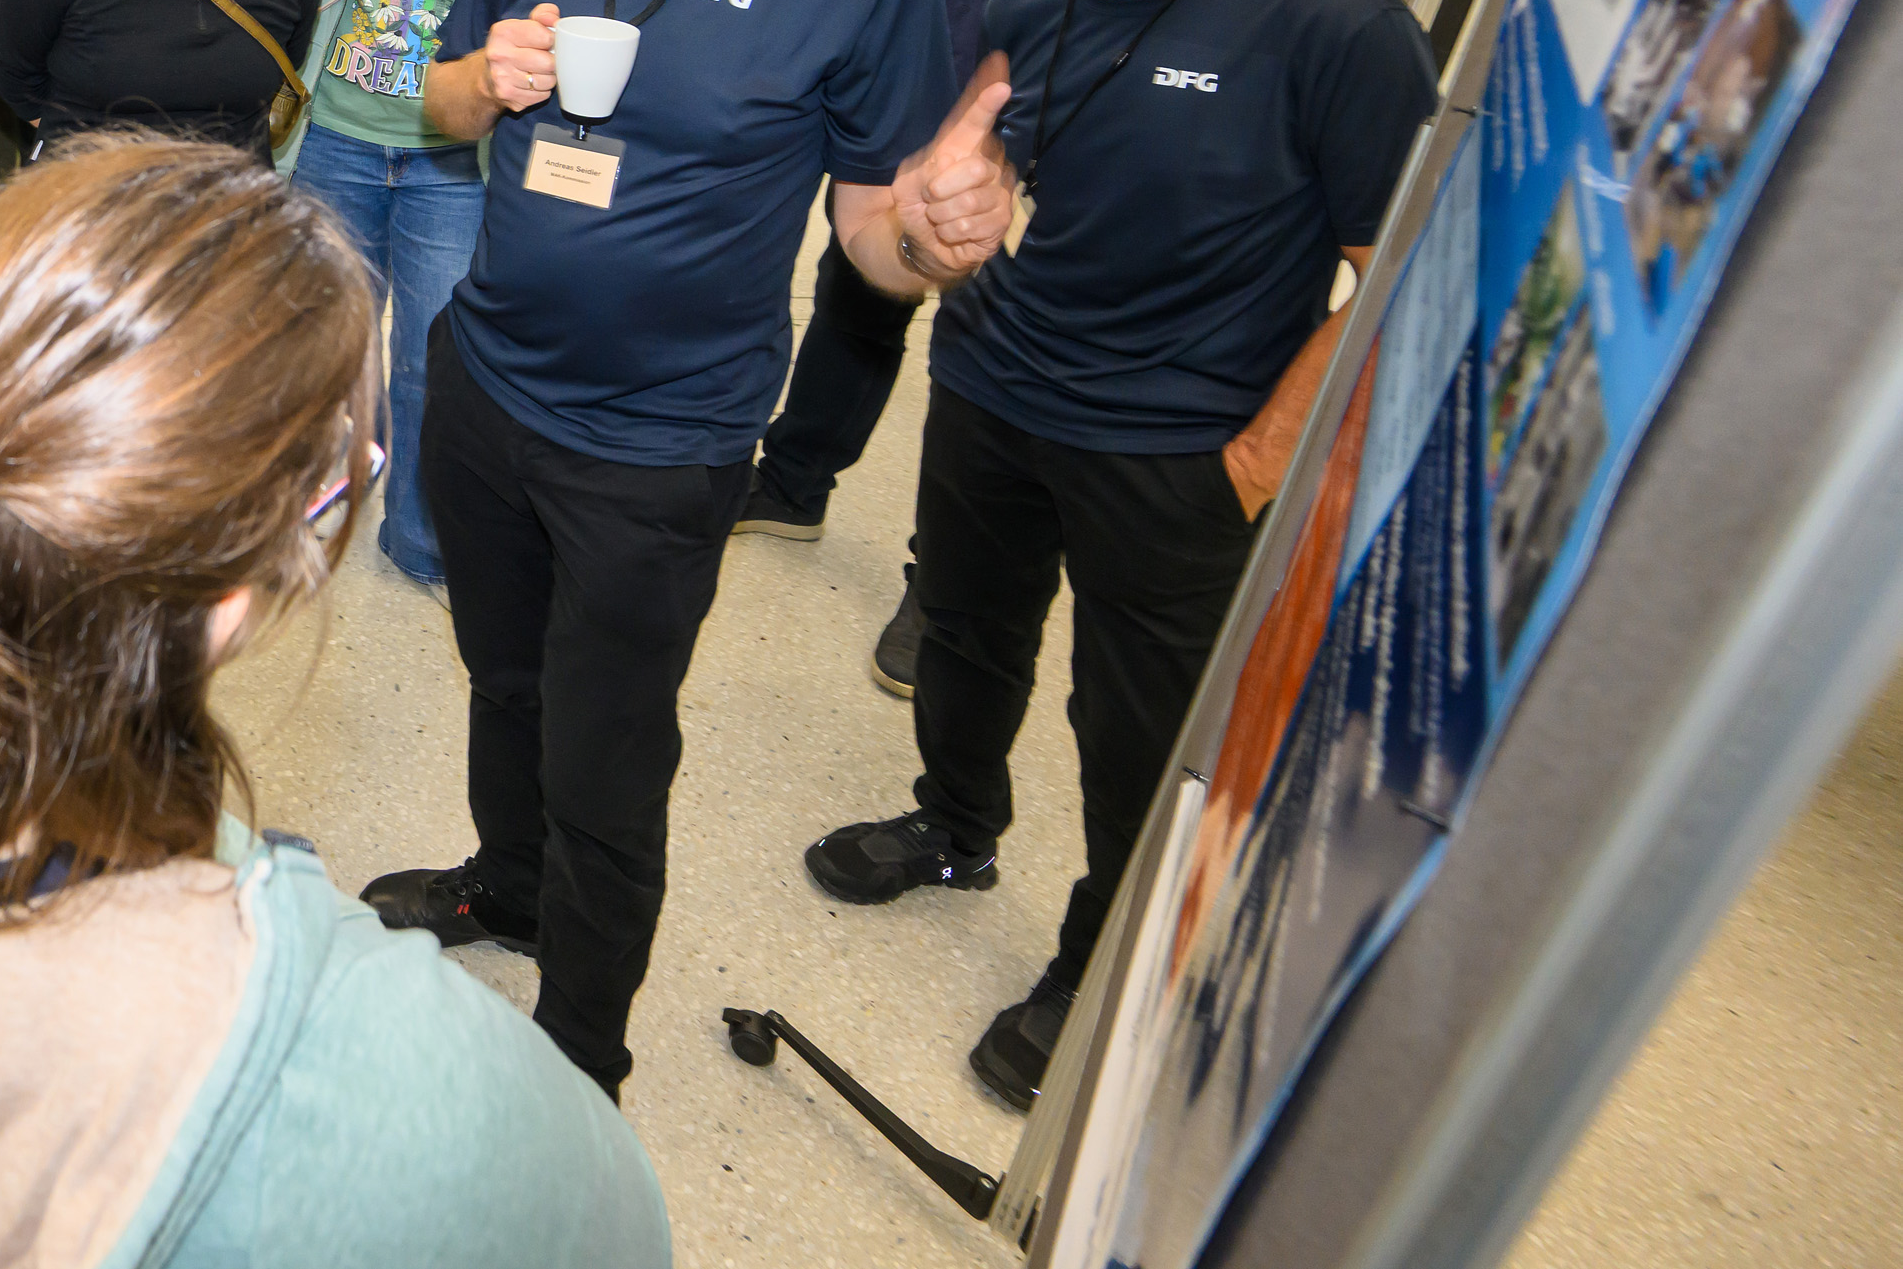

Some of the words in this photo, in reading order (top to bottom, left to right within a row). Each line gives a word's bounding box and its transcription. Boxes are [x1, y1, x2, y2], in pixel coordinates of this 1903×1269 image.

[326, 37, 429, 99] DREA
[1152, 66, 1219, 93] DFG
[545, 159, 574, 171] Andreas
